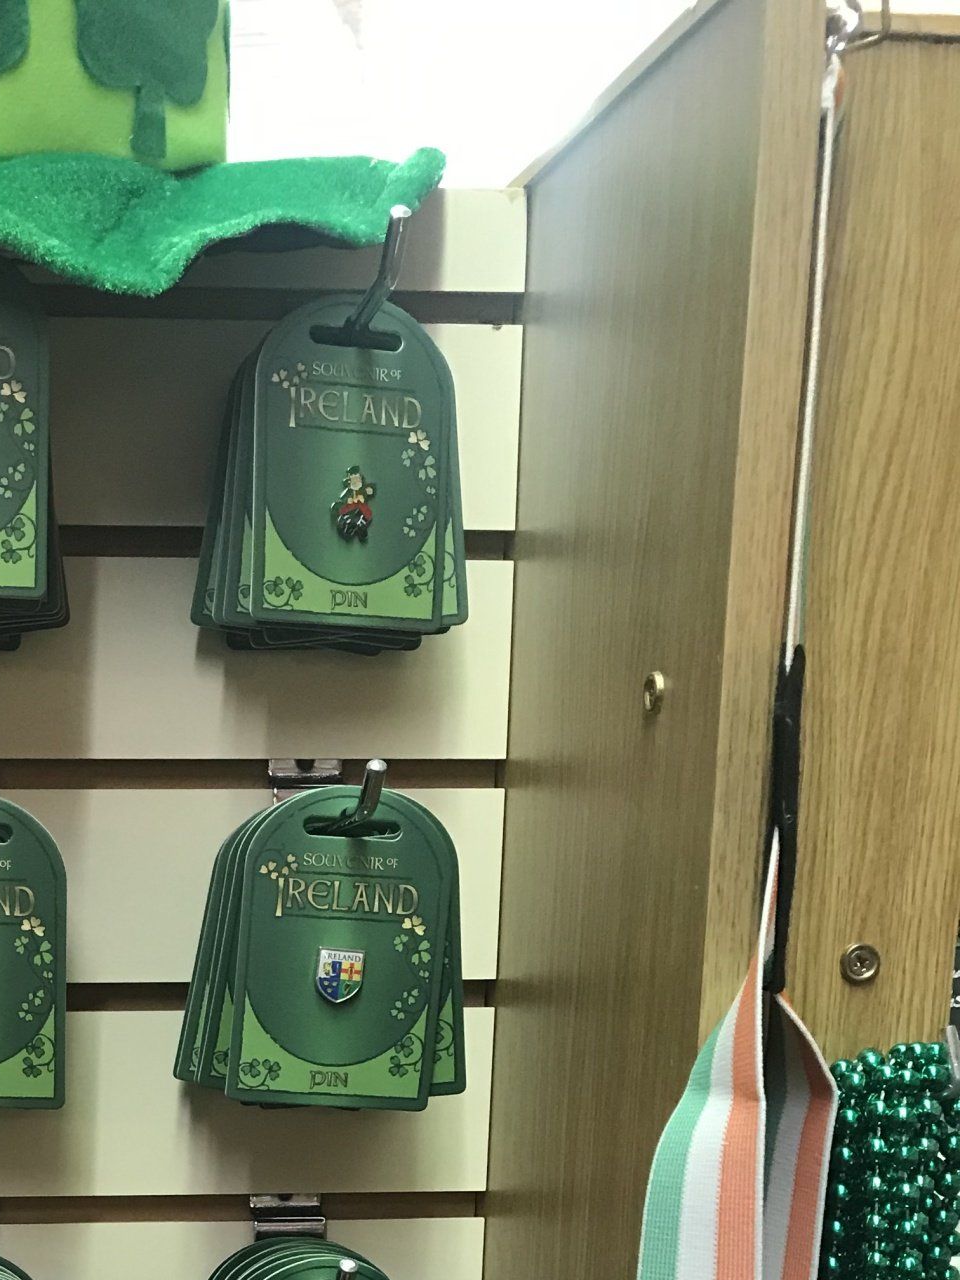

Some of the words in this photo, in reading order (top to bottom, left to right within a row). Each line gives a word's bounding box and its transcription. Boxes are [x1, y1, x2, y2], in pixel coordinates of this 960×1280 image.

[289, 387, 422, 428] IRELAND
[330, 589, 368, 610] PIN
[275, 877, 418, 916] IRELAND
[310, 1070, 348, 1089] PIN
